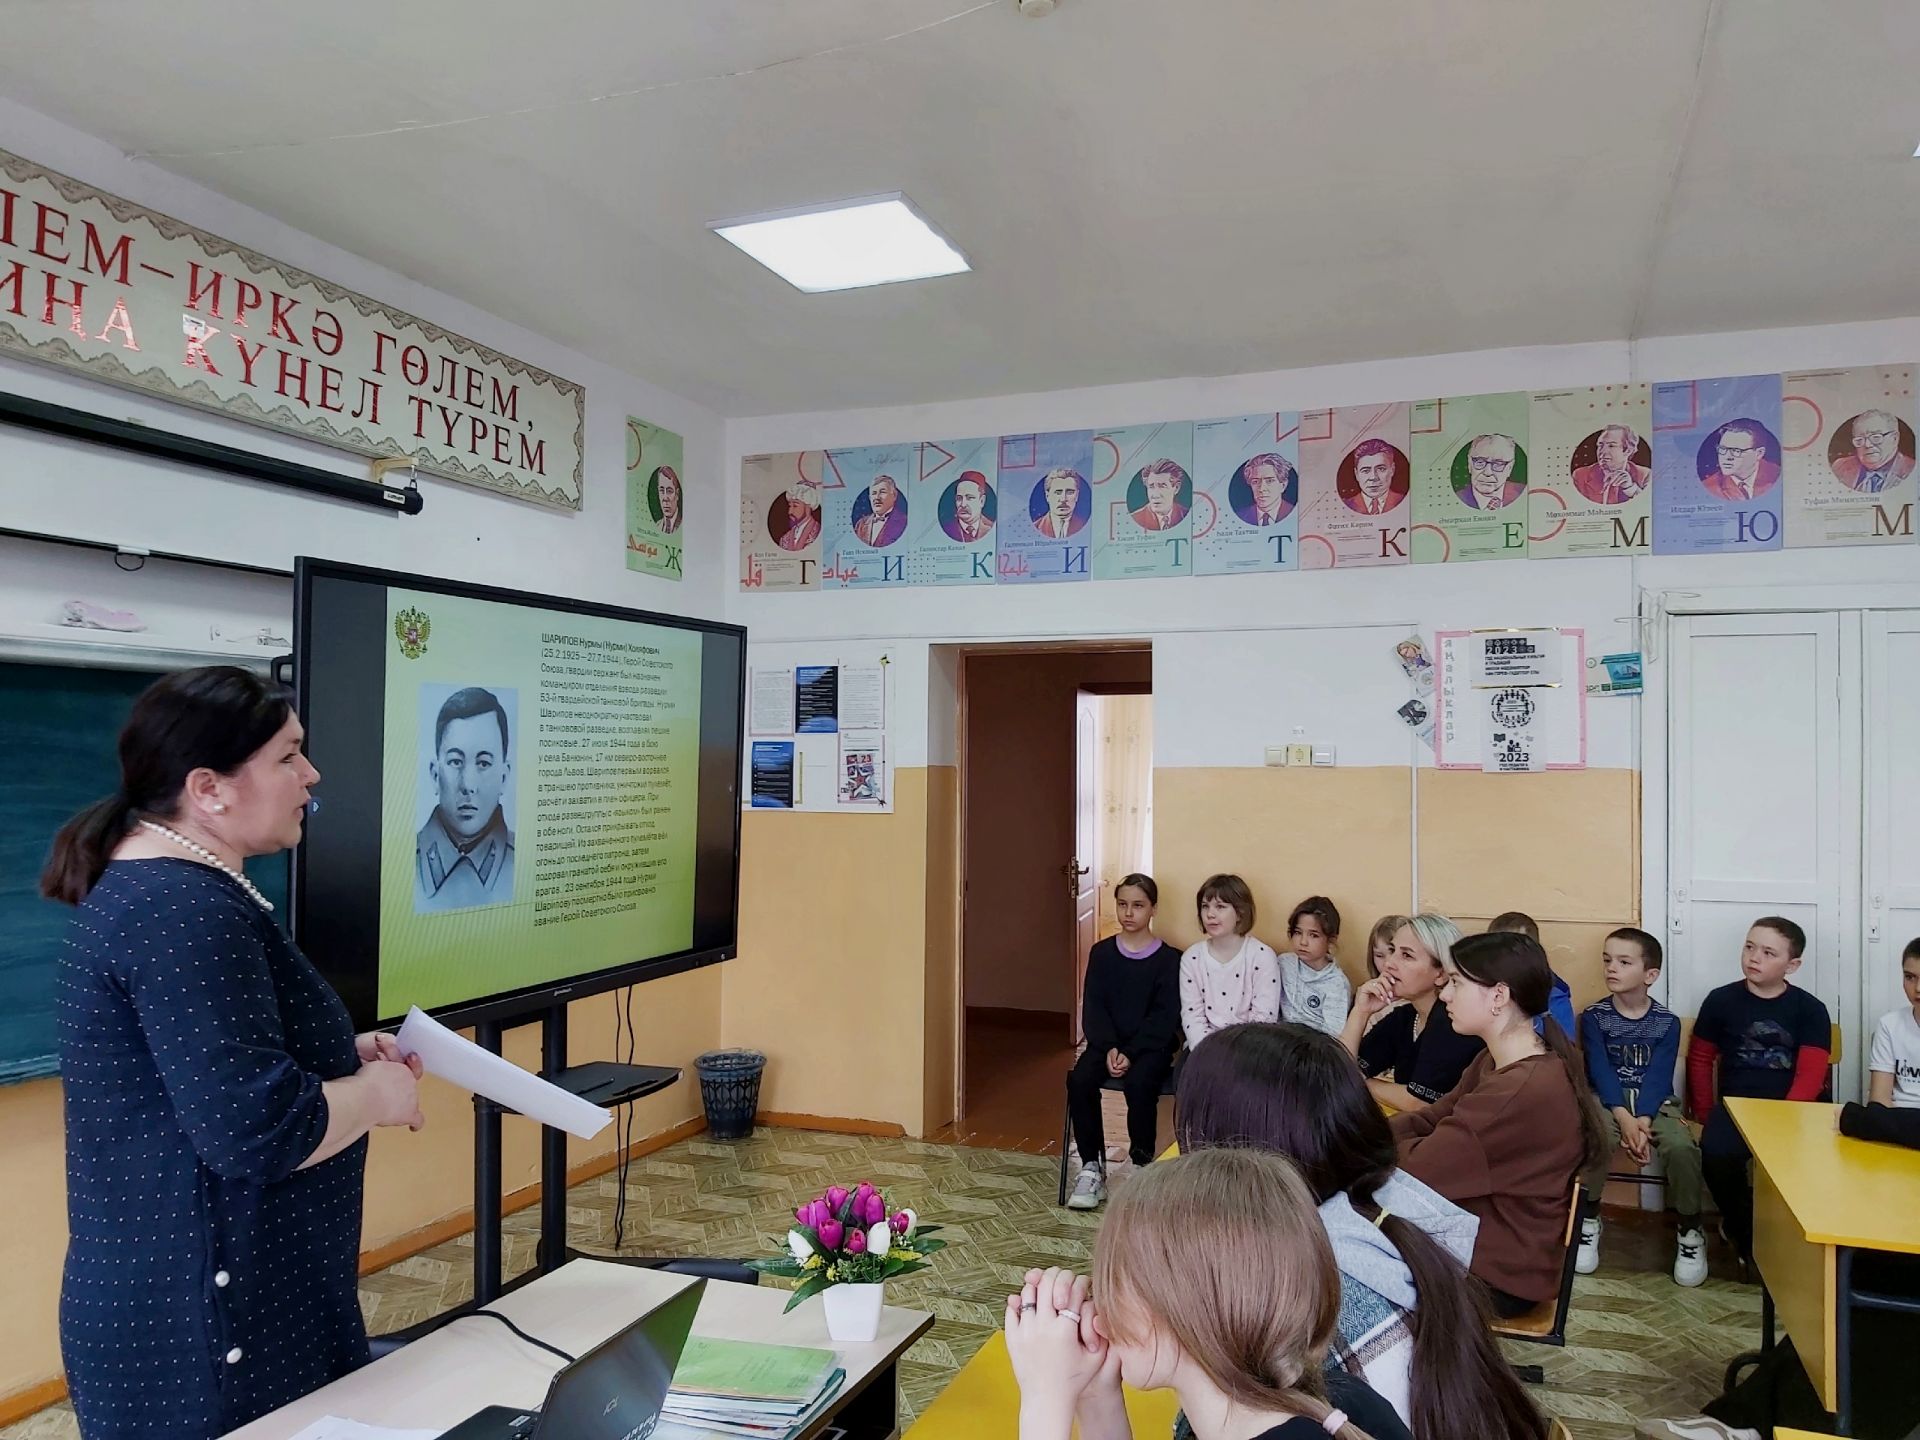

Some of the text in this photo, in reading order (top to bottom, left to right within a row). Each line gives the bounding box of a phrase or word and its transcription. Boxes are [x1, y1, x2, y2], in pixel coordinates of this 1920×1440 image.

[372, 330, 535, 430] ГӨЛЕМ,
[180, 322, 383, 425] КҮҢЕЛ
[408, 394, 547, 477] ТҮРЕМ
[1609, 516, 1650, 548] М
[1734, 510, 1778, 543] Ю
[1871, 503, 1914, 537] М
[1267, 535, 1293, 564] Т
[1378, 527, 1407, 558] К
[1502, 521, 1524, 549] Е
[969, 551, 994, 578] К
[1062, 545, 1089, 574] И
[1165, 538, 1189, 567] Т
[799, 559, 817, 585] Г
[881, 554, 905, 582] И
[1486, 645, 1518, 654] 2023
[1499, 752, 1530, 763] 2023
